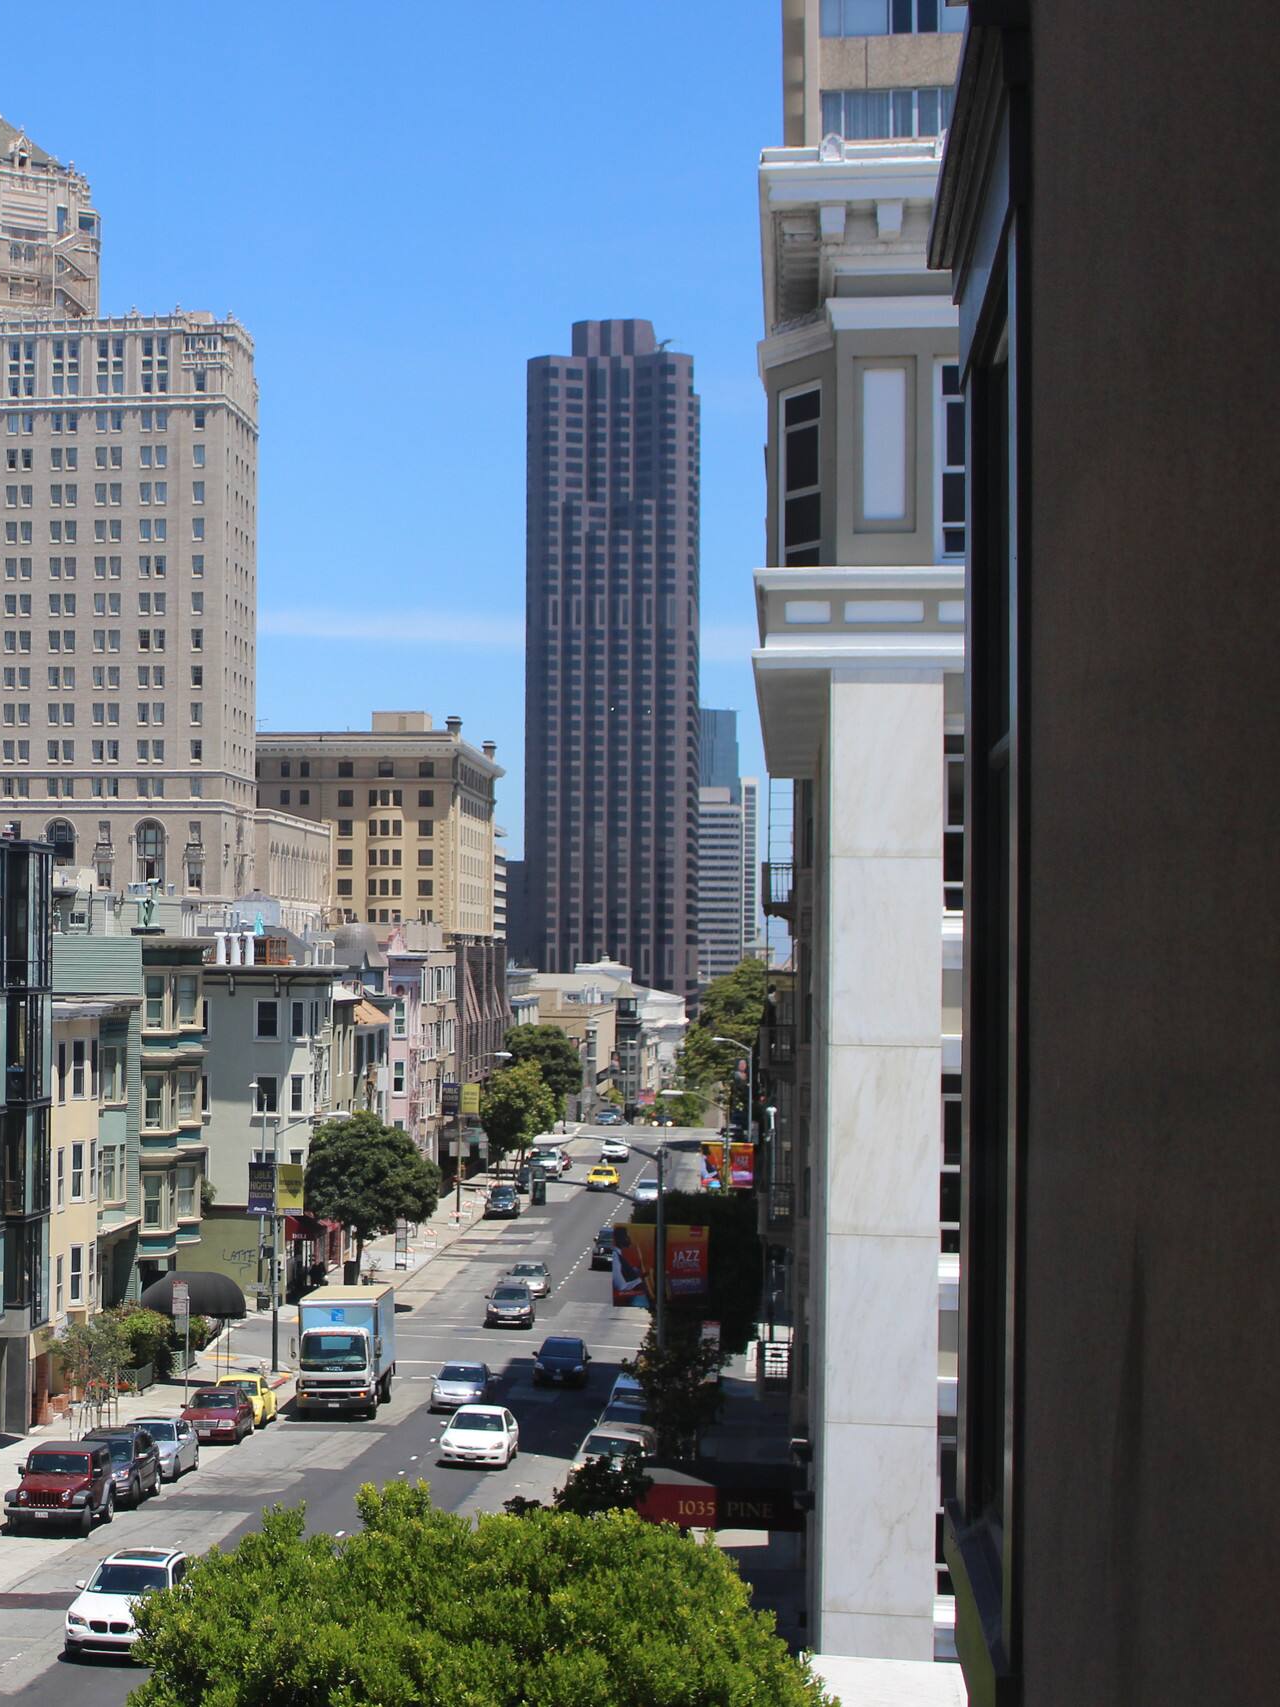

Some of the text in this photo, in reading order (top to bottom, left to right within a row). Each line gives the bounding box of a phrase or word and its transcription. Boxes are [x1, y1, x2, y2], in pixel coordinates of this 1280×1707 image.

[672, 1249, 700, 1262] JAZZ
[679, 1500, 774, 1519] 1035 PINE
